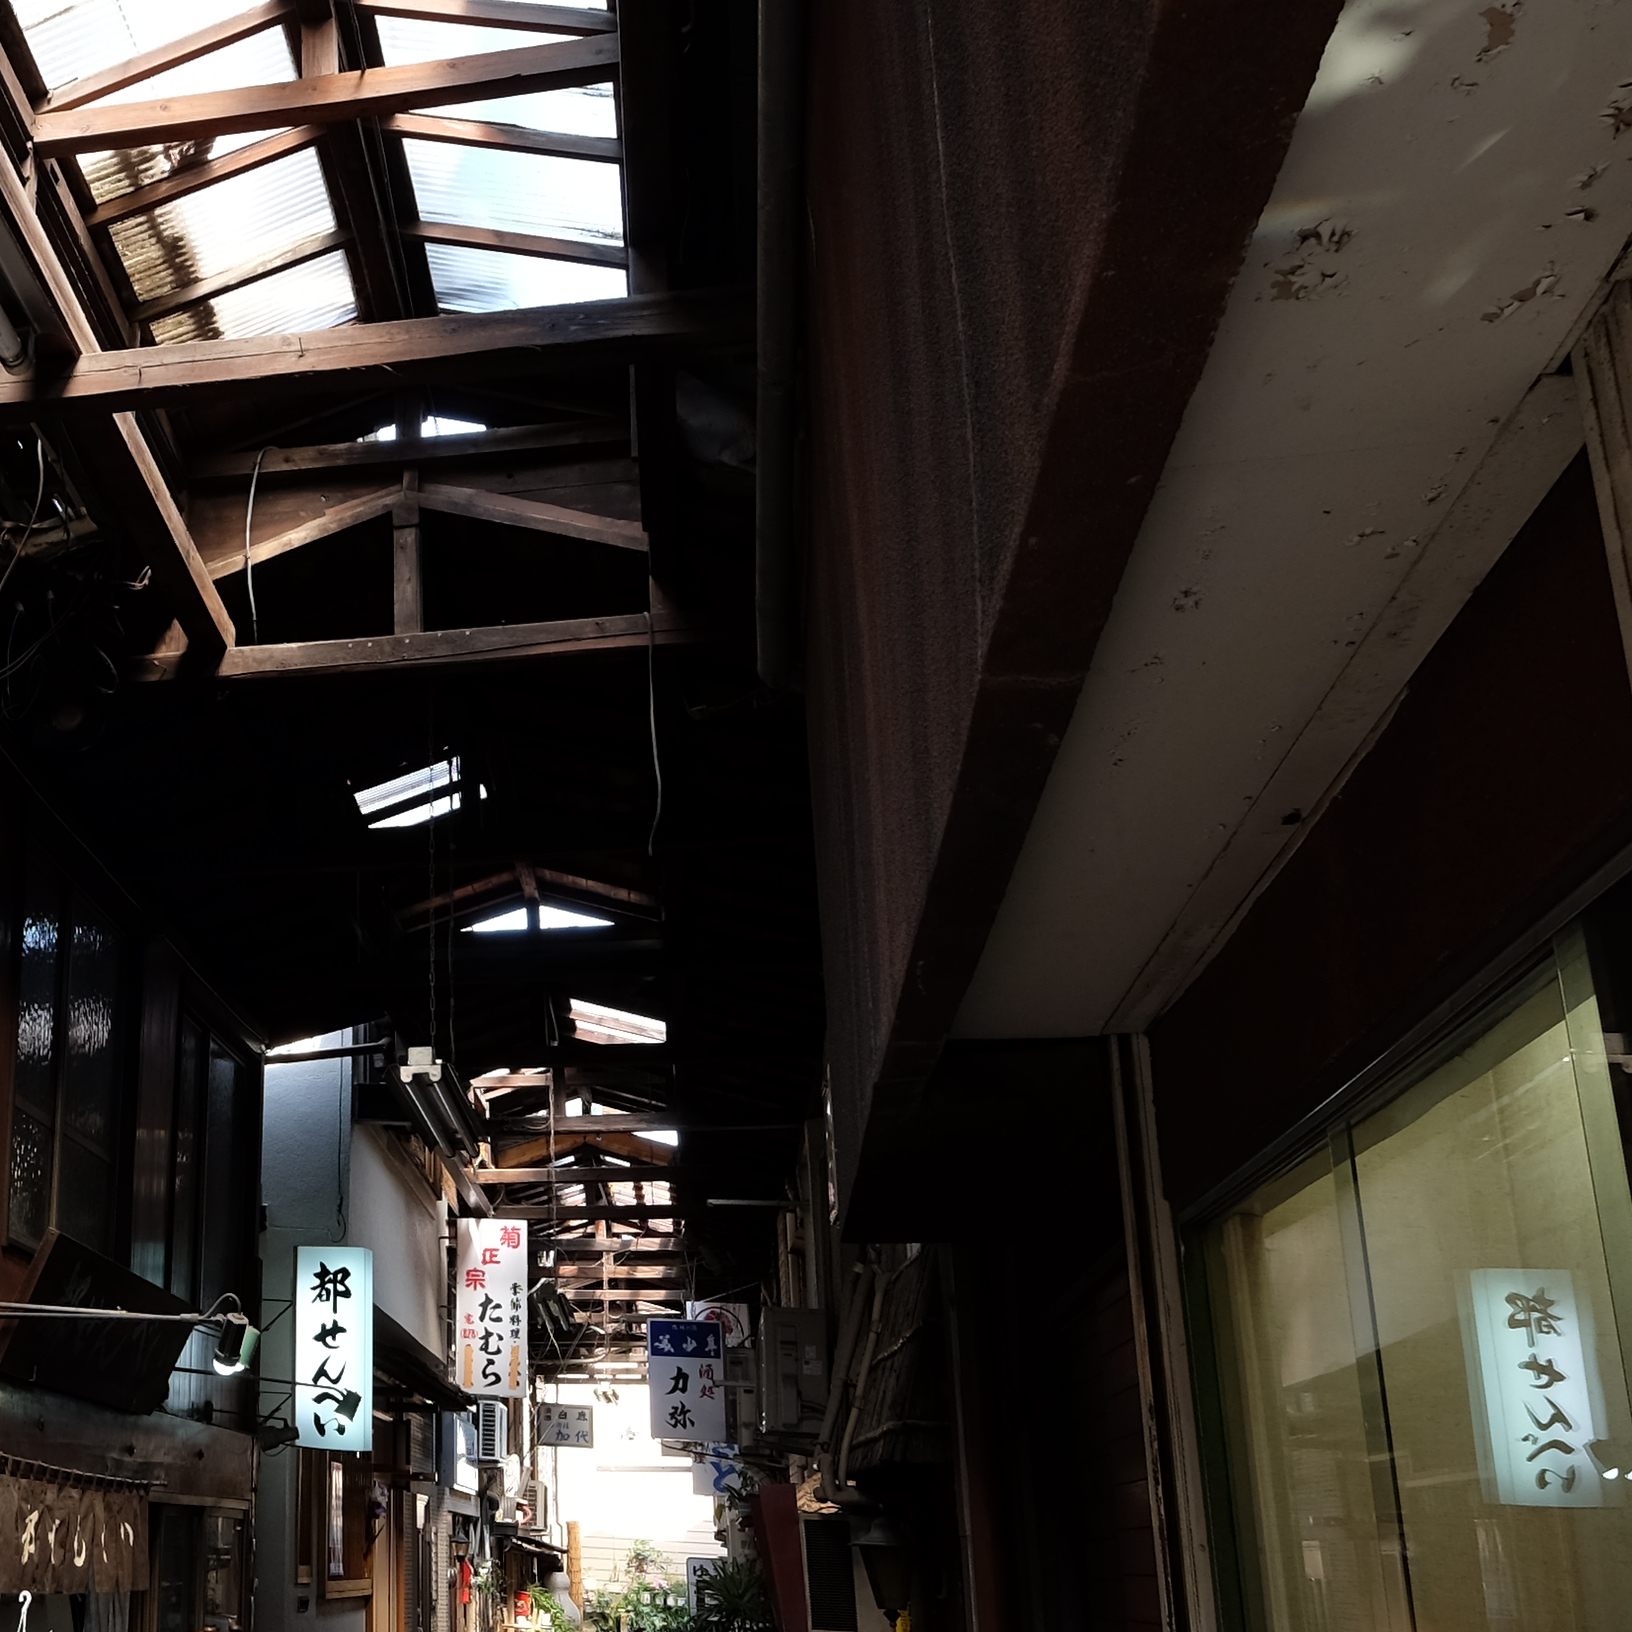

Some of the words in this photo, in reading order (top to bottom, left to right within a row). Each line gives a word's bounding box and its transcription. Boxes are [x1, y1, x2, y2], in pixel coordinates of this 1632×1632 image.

[465, 1225, 522, 1291] 菊正宗
[478, 1292, 504, 1388] たむら
[665, 1366, 695, 1429] 力弥
